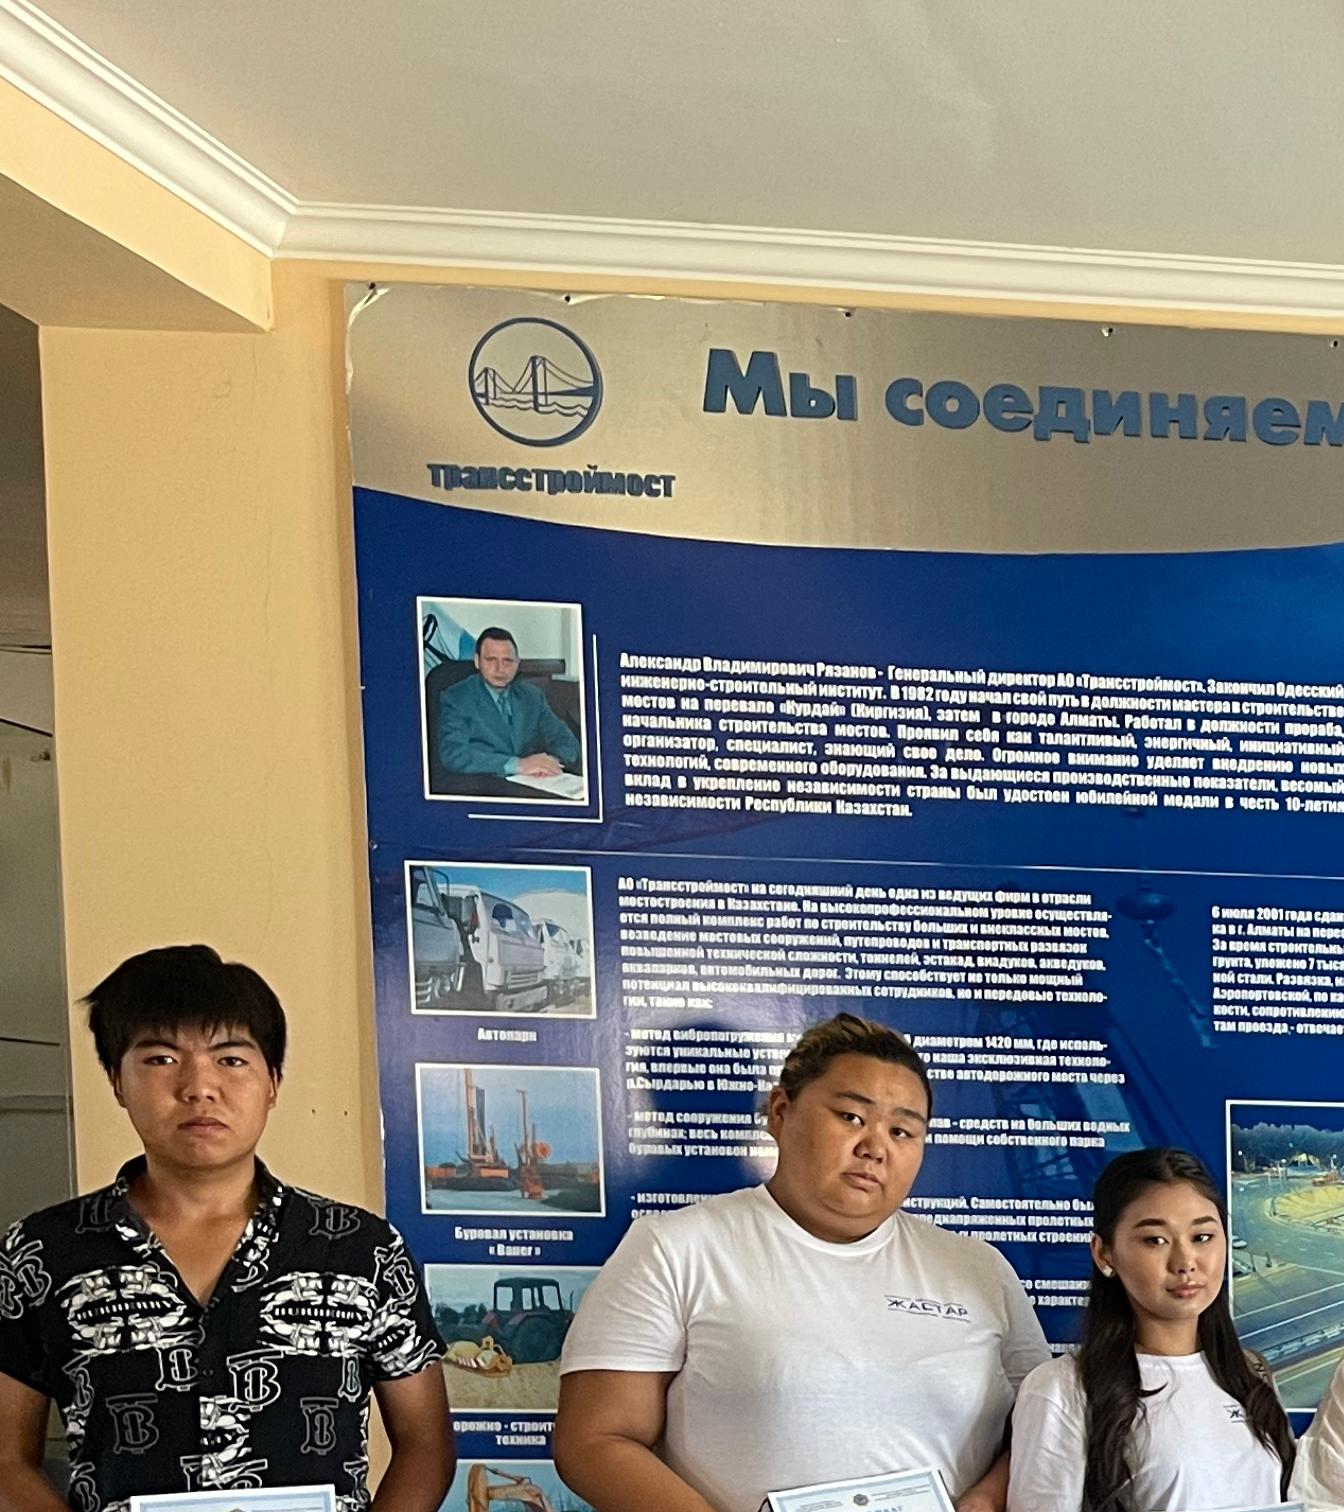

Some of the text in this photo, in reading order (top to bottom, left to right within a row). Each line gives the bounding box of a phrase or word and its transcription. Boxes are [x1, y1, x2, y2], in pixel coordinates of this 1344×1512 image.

[703, 348, 858, 420] Мы
[426, 463, 677, 498] трансстроймост
[620, 652, 702, 673] Александр
[702, 657, 815, 678] Владимирович
[816, 662, 877, 679] Рязанов
[887, 665, 986, 684] Генеральный
[988, 672, 1056, 689] директор
[1056, 672, 1075, 688] АО
[1207, 679, 1275, 696] Закончил
[1276, 681, 1344, 700] Одесский
[623, 714, 712, 731] начальника
[718, 719, 828, 736] строительства
[897, 724, 959, 742] Проявил
[965, 727, 1000, 743] себя
[1006, 731, 1032, 744] как
[625, 773, 672, 790] вклад
[693, 776, 781, 793] укрепление
[786, 780, 901, 797] независимости
[906, 785, 961, 800] страны
[966, 785, 998, 801] был
[1003, 788, 1070, 805] удостоен
[1075, 788, 1158, 806] юбилейной
[1163, 794, 1219, 810] медали
[1239, 797, 1279, 810] честь
[625, 793, 741, 810] независимости
[745, 796, 832, 815] Республики
[508, 1228, 574, 1242] установка
[453, 1420, 502, 1432] орожно
